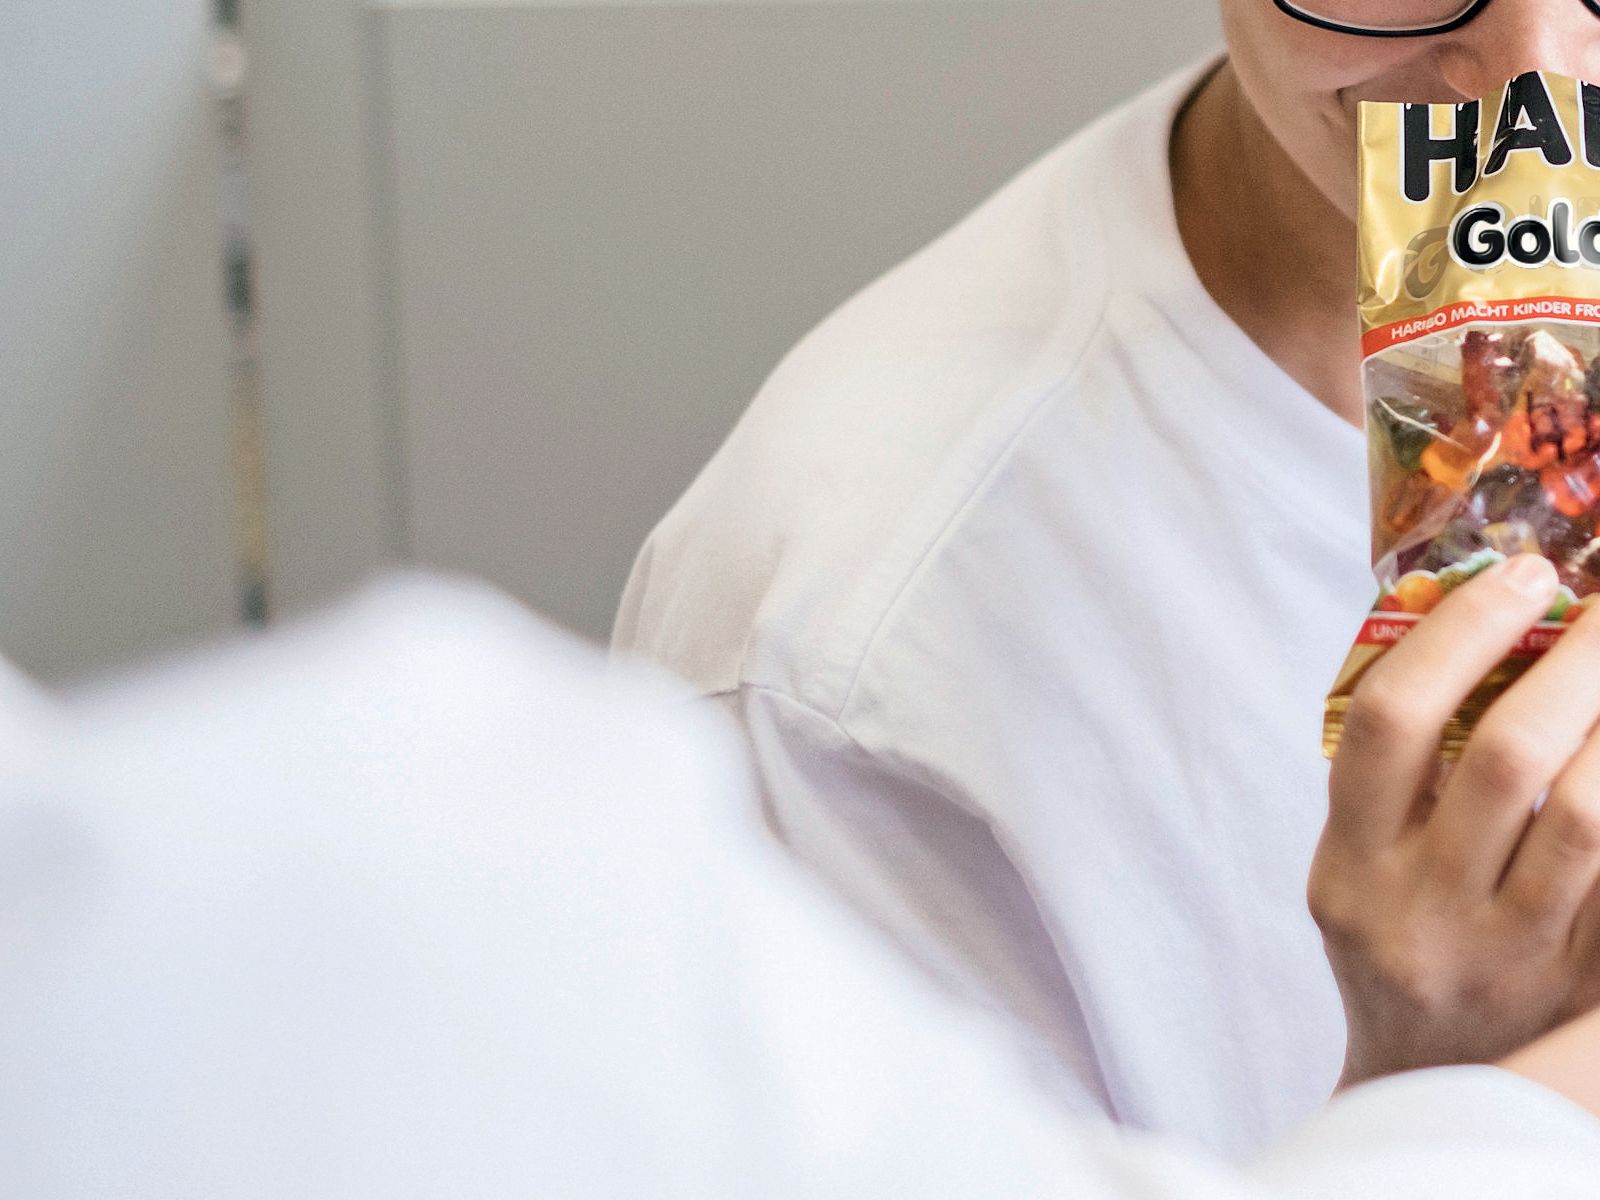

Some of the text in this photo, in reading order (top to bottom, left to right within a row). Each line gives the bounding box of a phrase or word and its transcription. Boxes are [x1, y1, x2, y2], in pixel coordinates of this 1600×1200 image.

[1391, 312, 1447, 340] HARIBO
[1450, 303, 1510, 323] MACHT
[1513, 301, 1571, 316] KINDER
